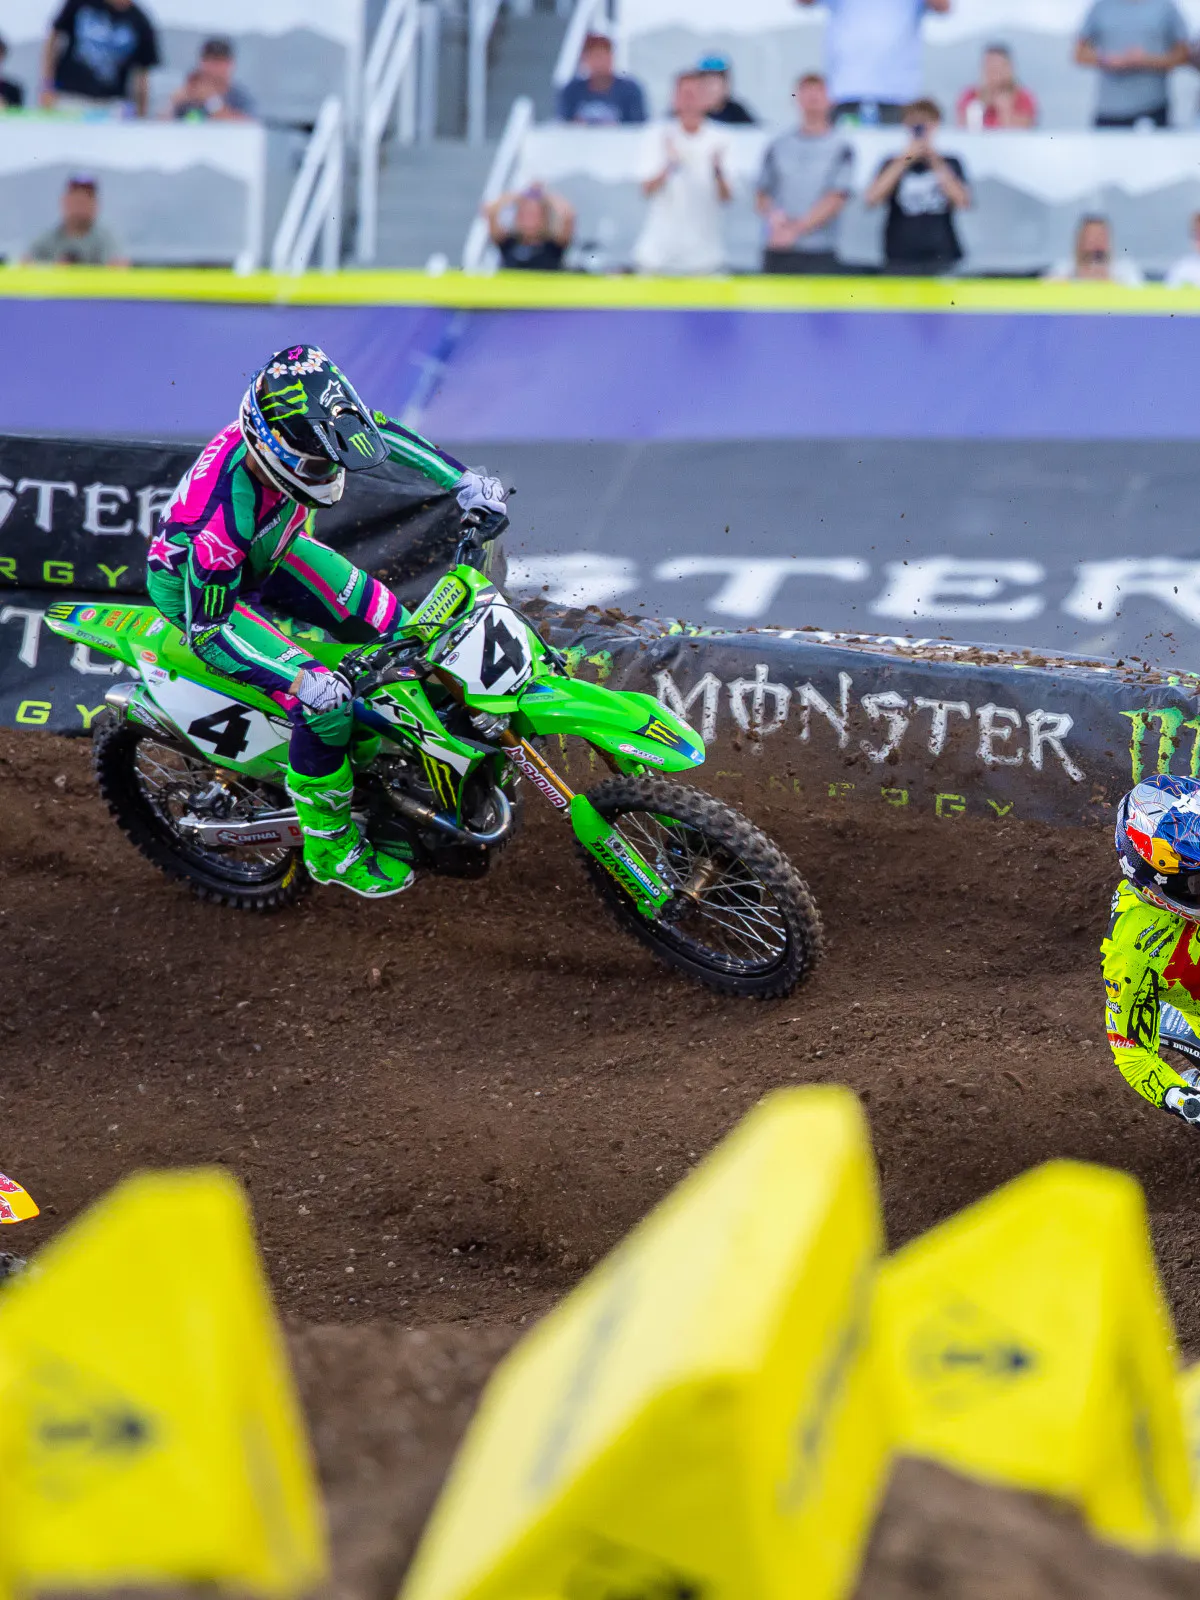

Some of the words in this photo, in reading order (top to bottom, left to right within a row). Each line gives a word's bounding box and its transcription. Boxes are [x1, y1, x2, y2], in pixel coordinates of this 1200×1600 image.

[251, 406, 291, 460] OAKLEY
[480, 608, 525, 691] 4
[188, 703, 254, 760] 4
[371, 688, 447, 746] KX
[653, 663, 1087, 782] MONSTER
[522, 761, 568, 808] SHOWA
[626, 858, 661, 897] CARRILLO
